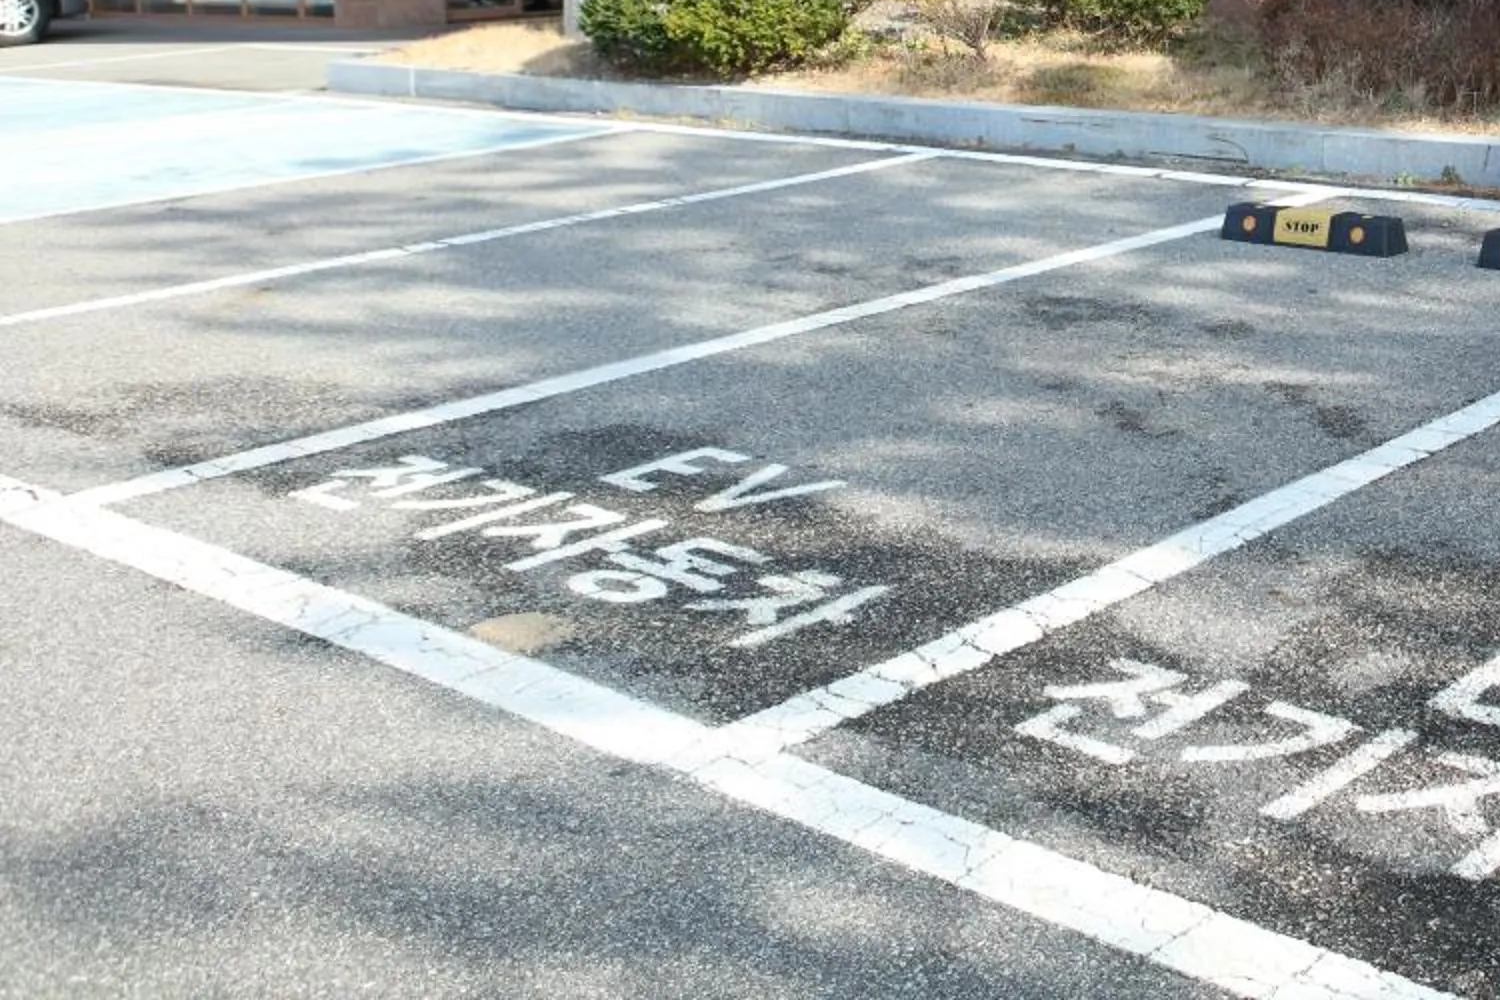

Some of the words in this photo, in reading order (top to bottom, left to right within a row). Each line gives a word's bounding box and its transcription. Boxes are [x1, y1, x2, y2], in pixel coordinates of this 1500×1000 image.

[1283, 220, 1320, 233] STOP
[602, 446, 848, 513] EV
[286, 455, 894, 649] 전기자동차
